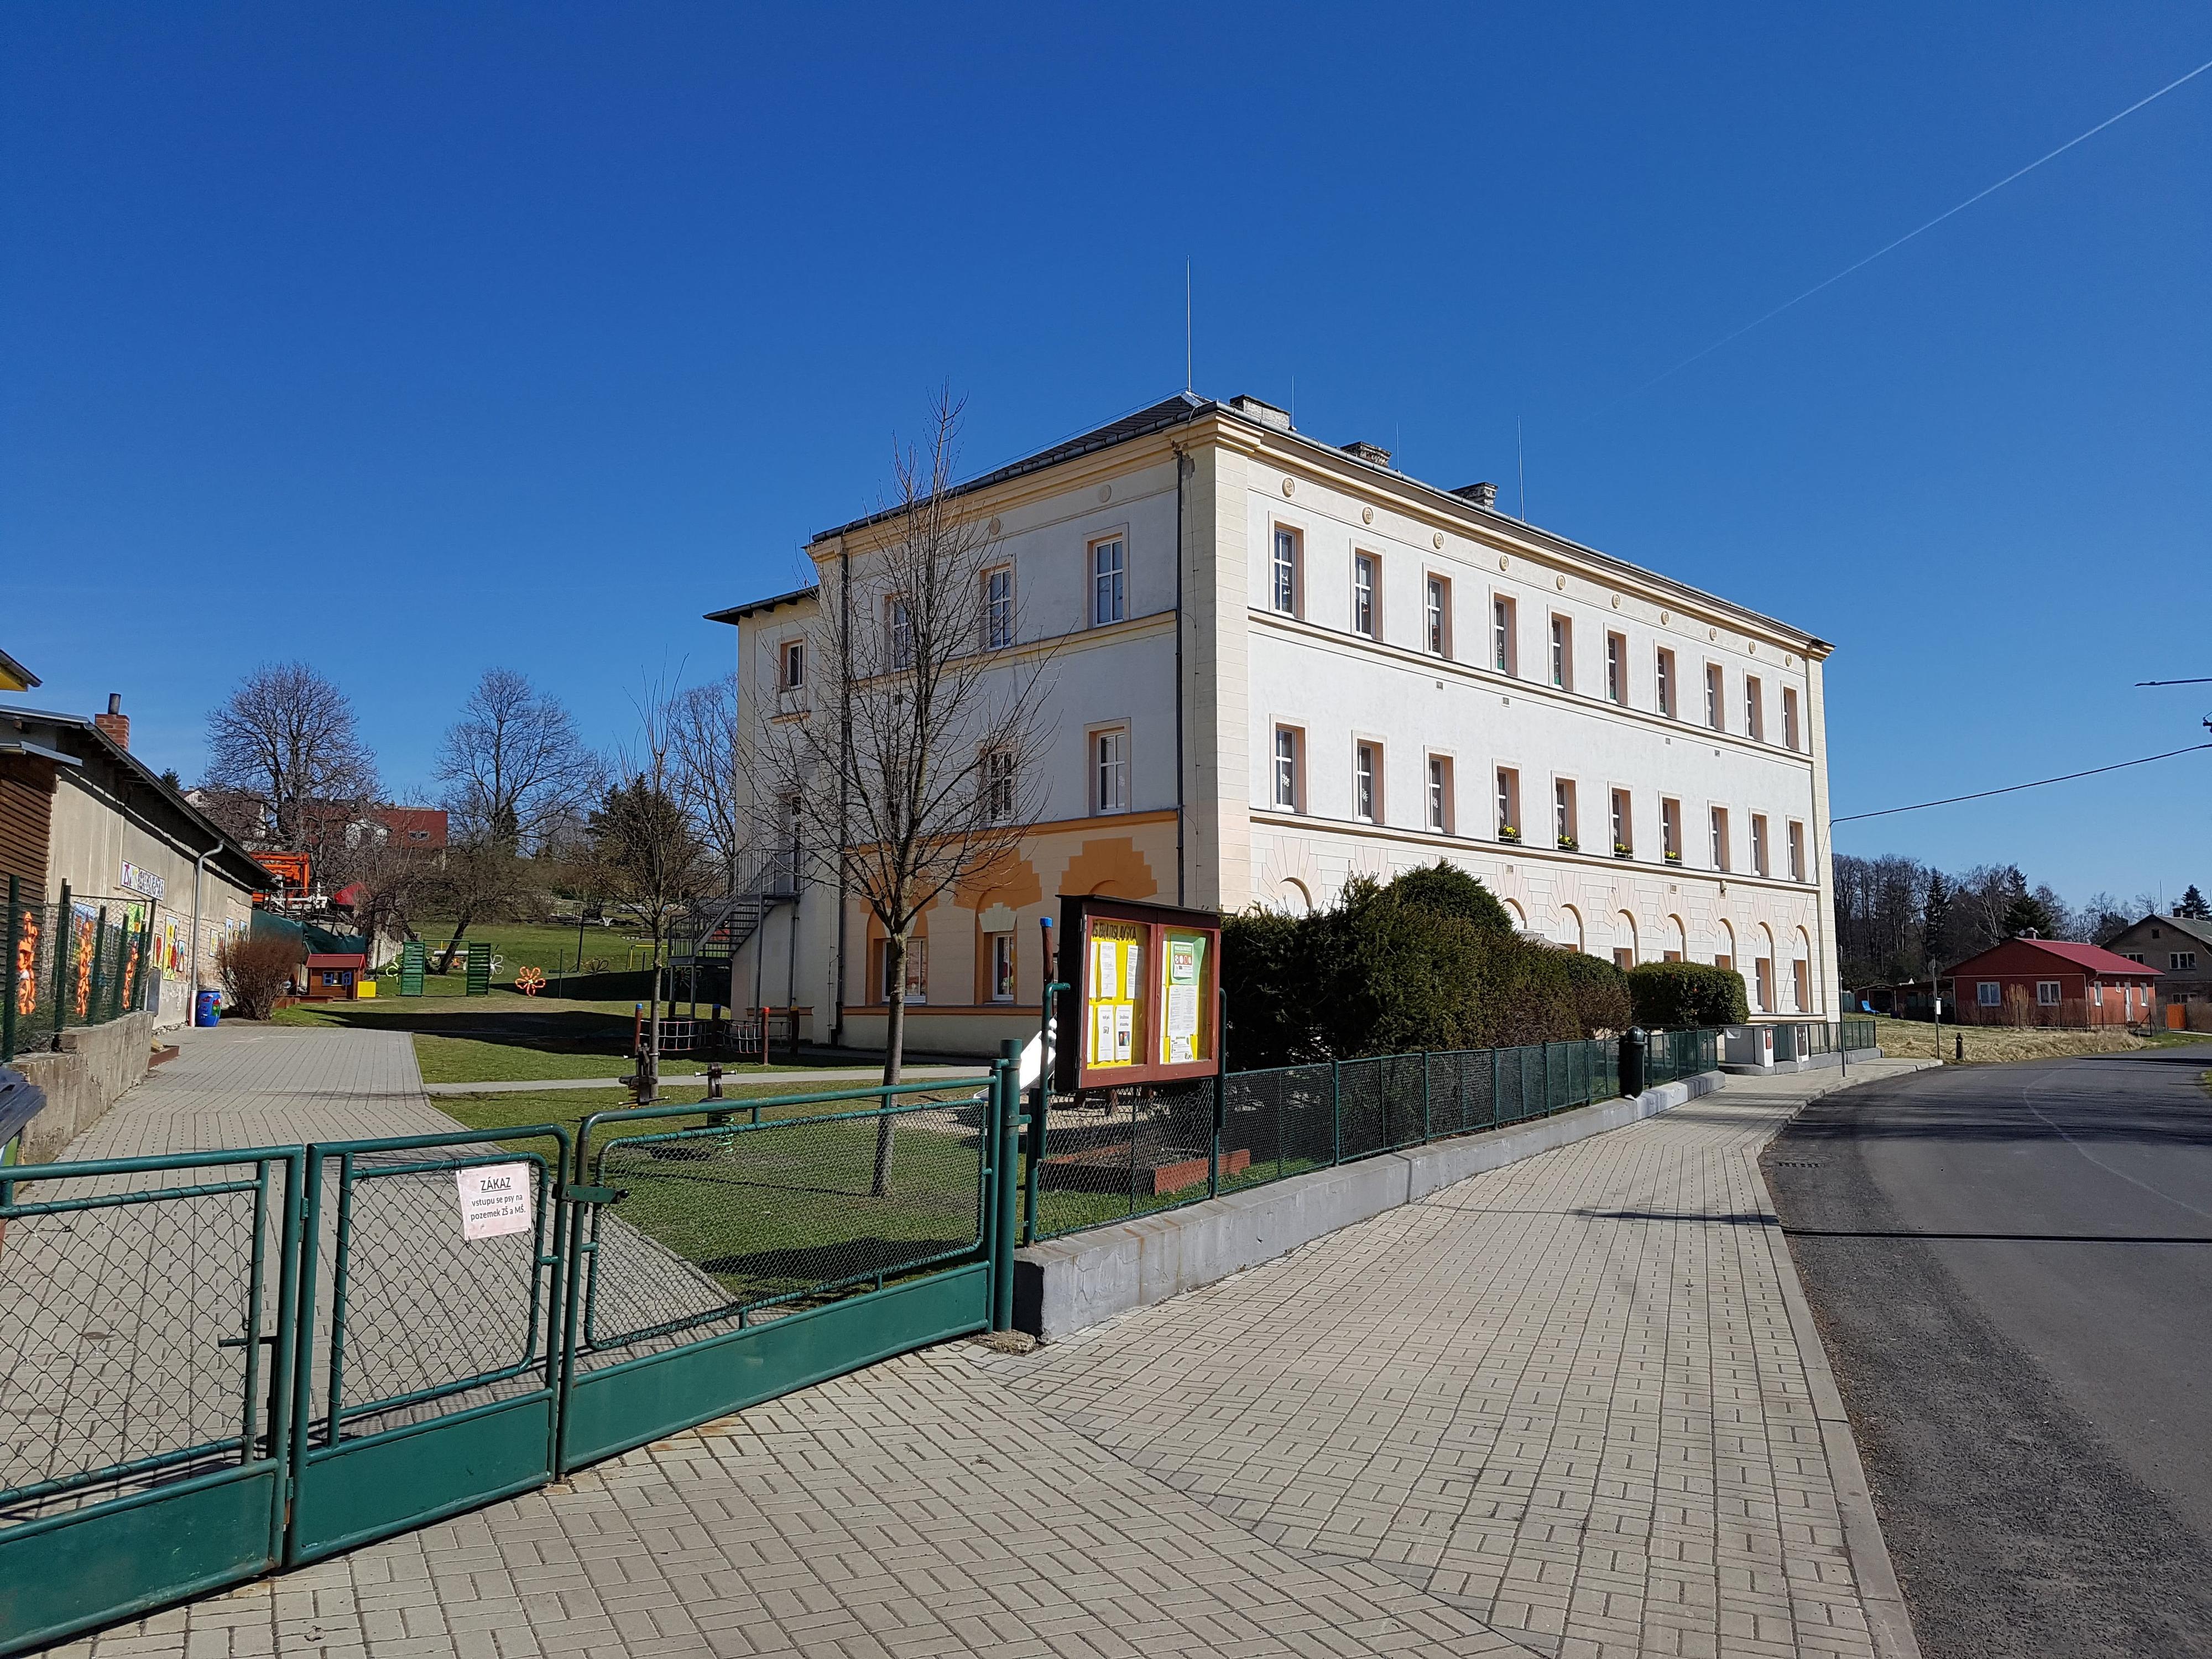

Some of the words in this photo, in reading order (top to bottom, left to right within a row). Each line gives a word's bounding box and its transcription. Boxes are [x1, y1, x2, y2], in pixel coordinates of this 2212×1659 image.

[480, 1176, 511, 1191] ZÁKAZ
[471, 1198, 495, 1207] vstupu
[504, 1195, 514, 1204] psy
[470, 1208, 500, 1222] pozemek
[502, 1206, 508, 1215] ZŠ
[514, 1203, 526, 1214] MŠ.
